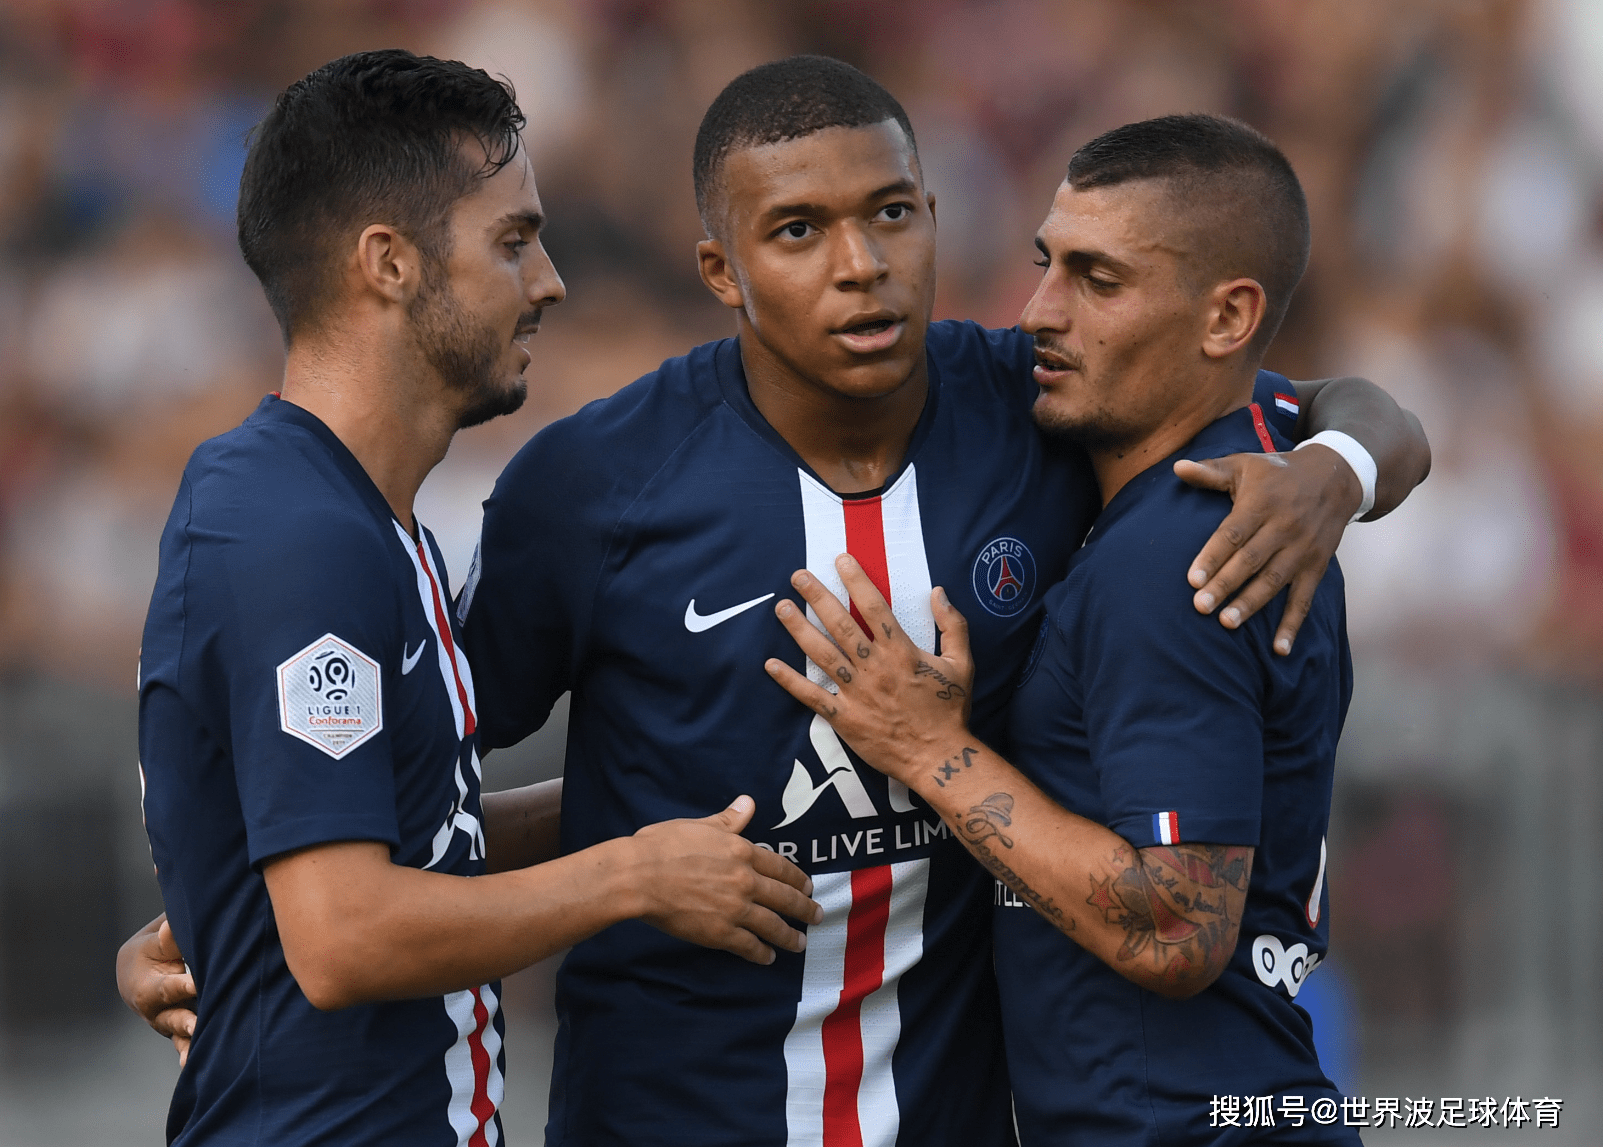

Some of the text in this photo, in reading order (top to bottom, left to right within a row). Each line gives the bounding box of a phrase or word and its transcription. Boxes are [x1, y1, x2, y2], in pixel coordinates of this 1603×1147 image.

[981, 541, 1023, 565] PARIS
[308, 705, 361, 715] LIGUE 1
[308, 716, 362, 725] Conforama
[811, 827, 885, 863] LIVE
[895, 819, 955, 850] LIM
